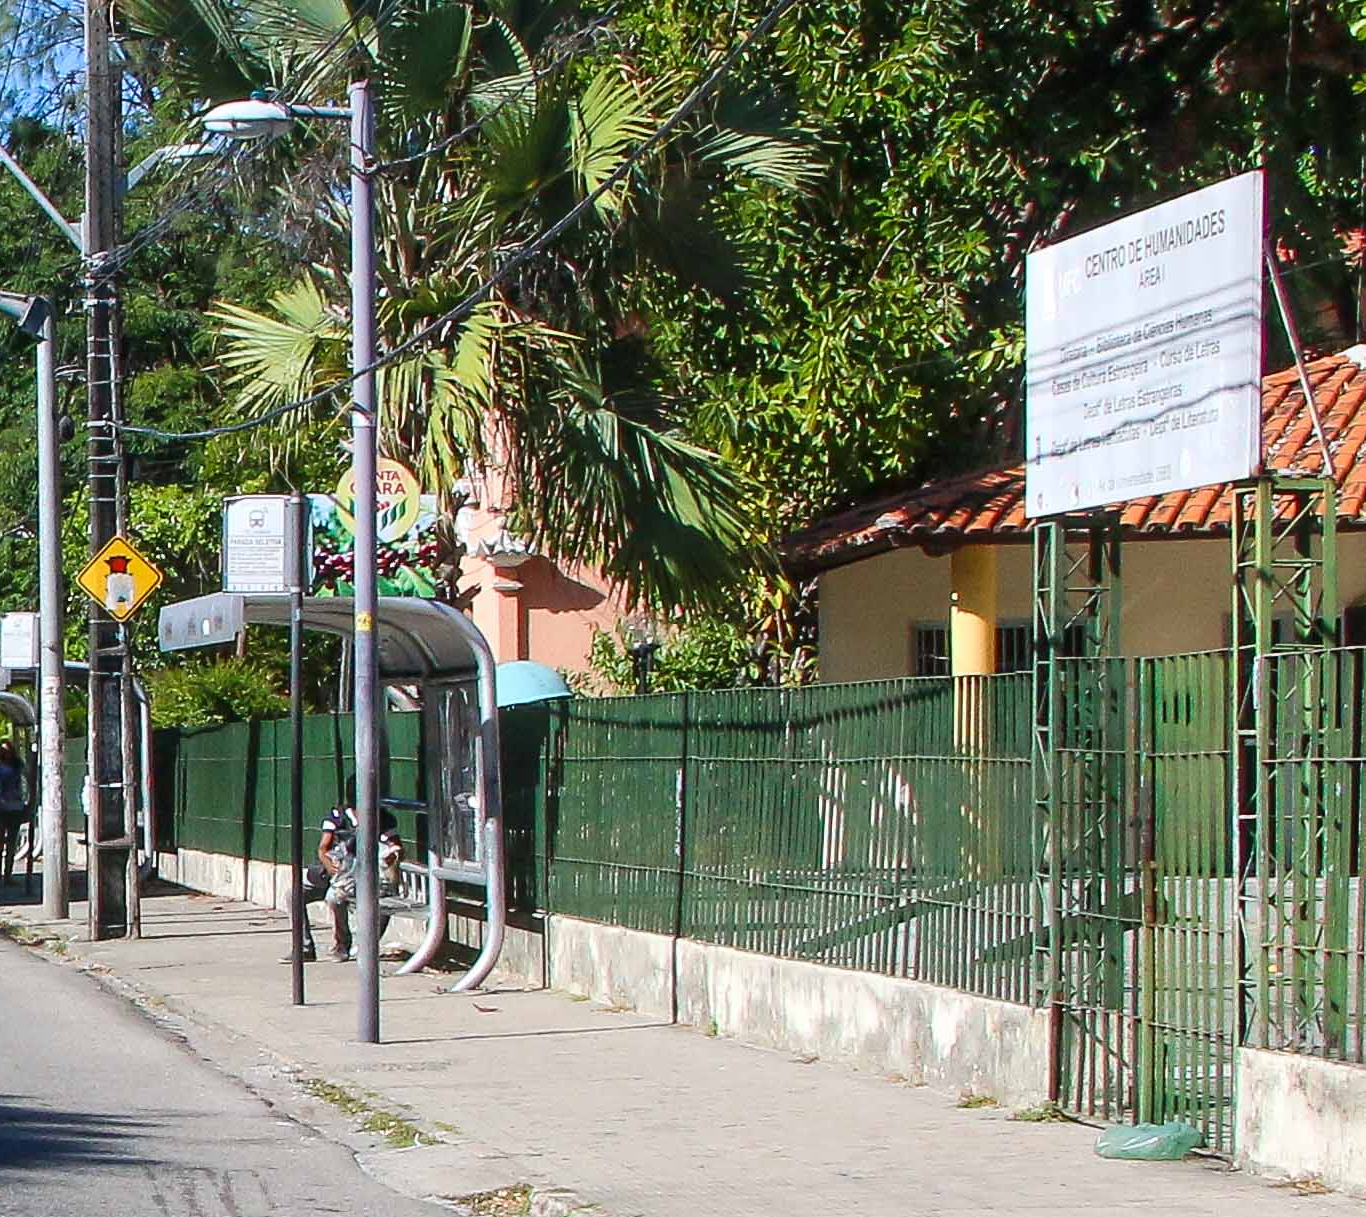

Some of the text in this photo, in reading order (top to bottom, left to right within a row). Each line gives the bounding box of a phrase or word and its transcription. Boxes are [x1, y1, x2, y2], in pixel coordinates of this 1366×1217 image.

[1085, 209, 1226, 279] CENTRO DE HUMANIDADES
